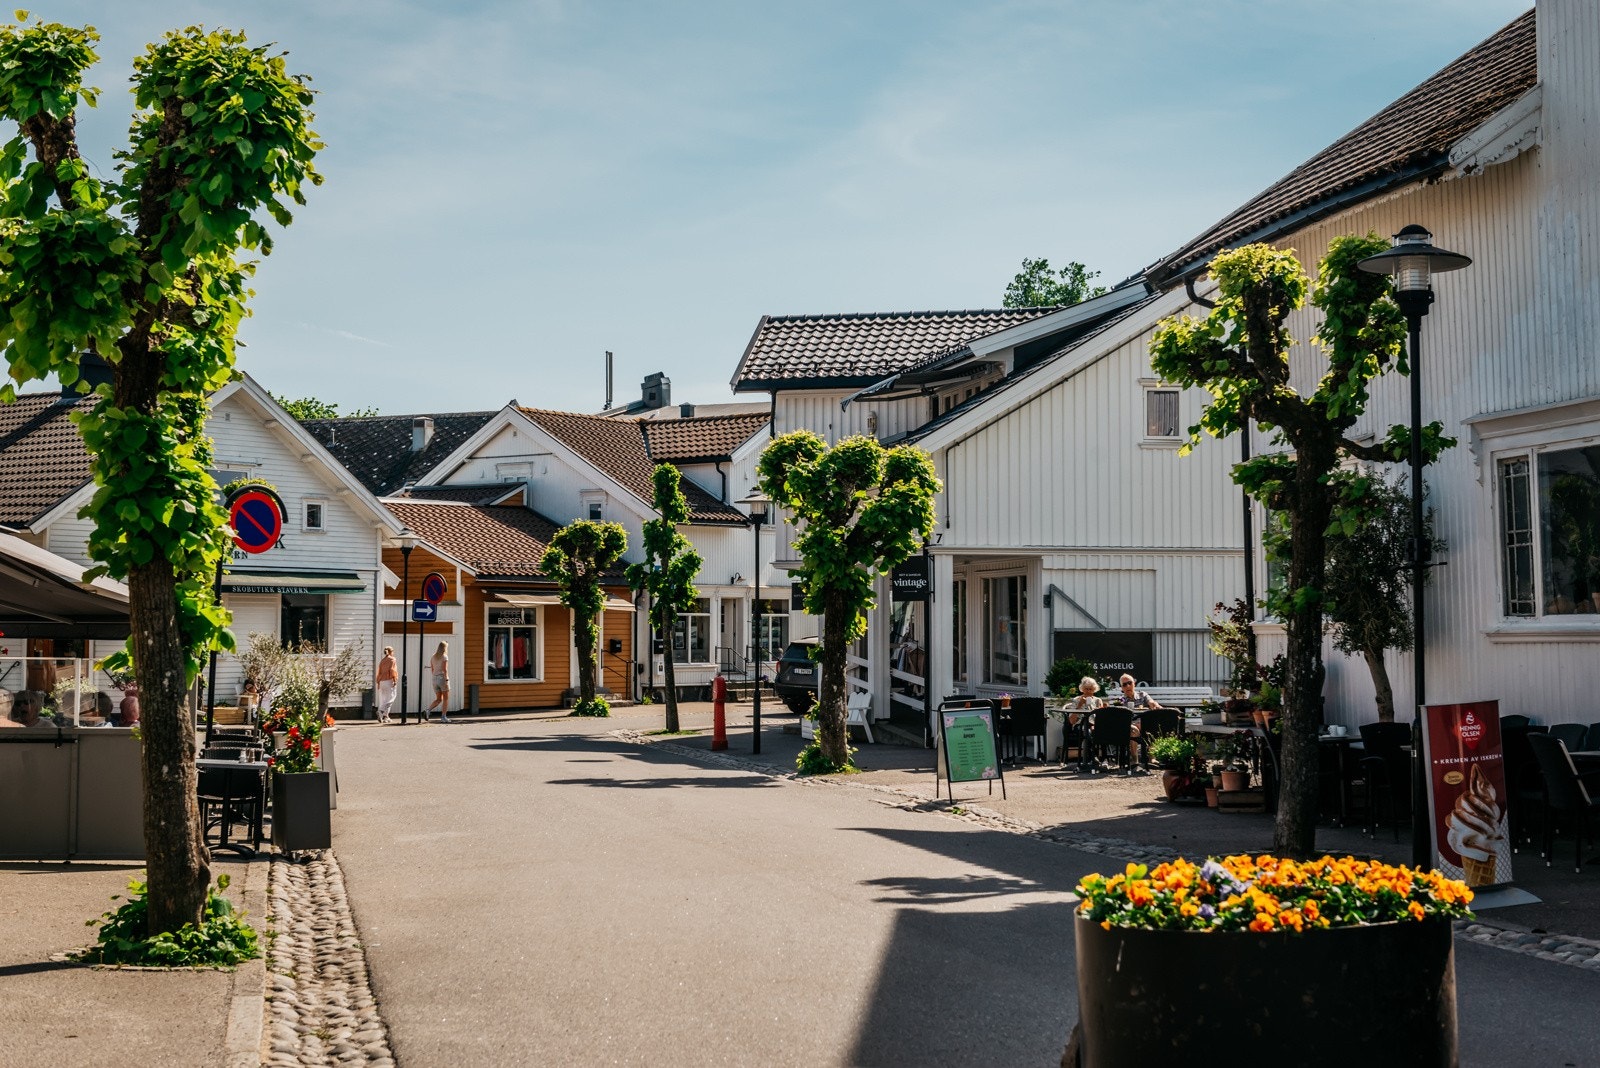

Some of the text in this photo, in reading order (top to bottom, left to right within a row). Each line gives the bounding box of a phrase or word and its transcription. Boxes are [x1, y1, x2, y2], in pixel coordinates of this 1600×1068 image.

[936, 533, 943, 544] 7
[893, 578, 927, 588] vintage
[232, 585, 309, 594] SKOBUTIKK STAVERN
